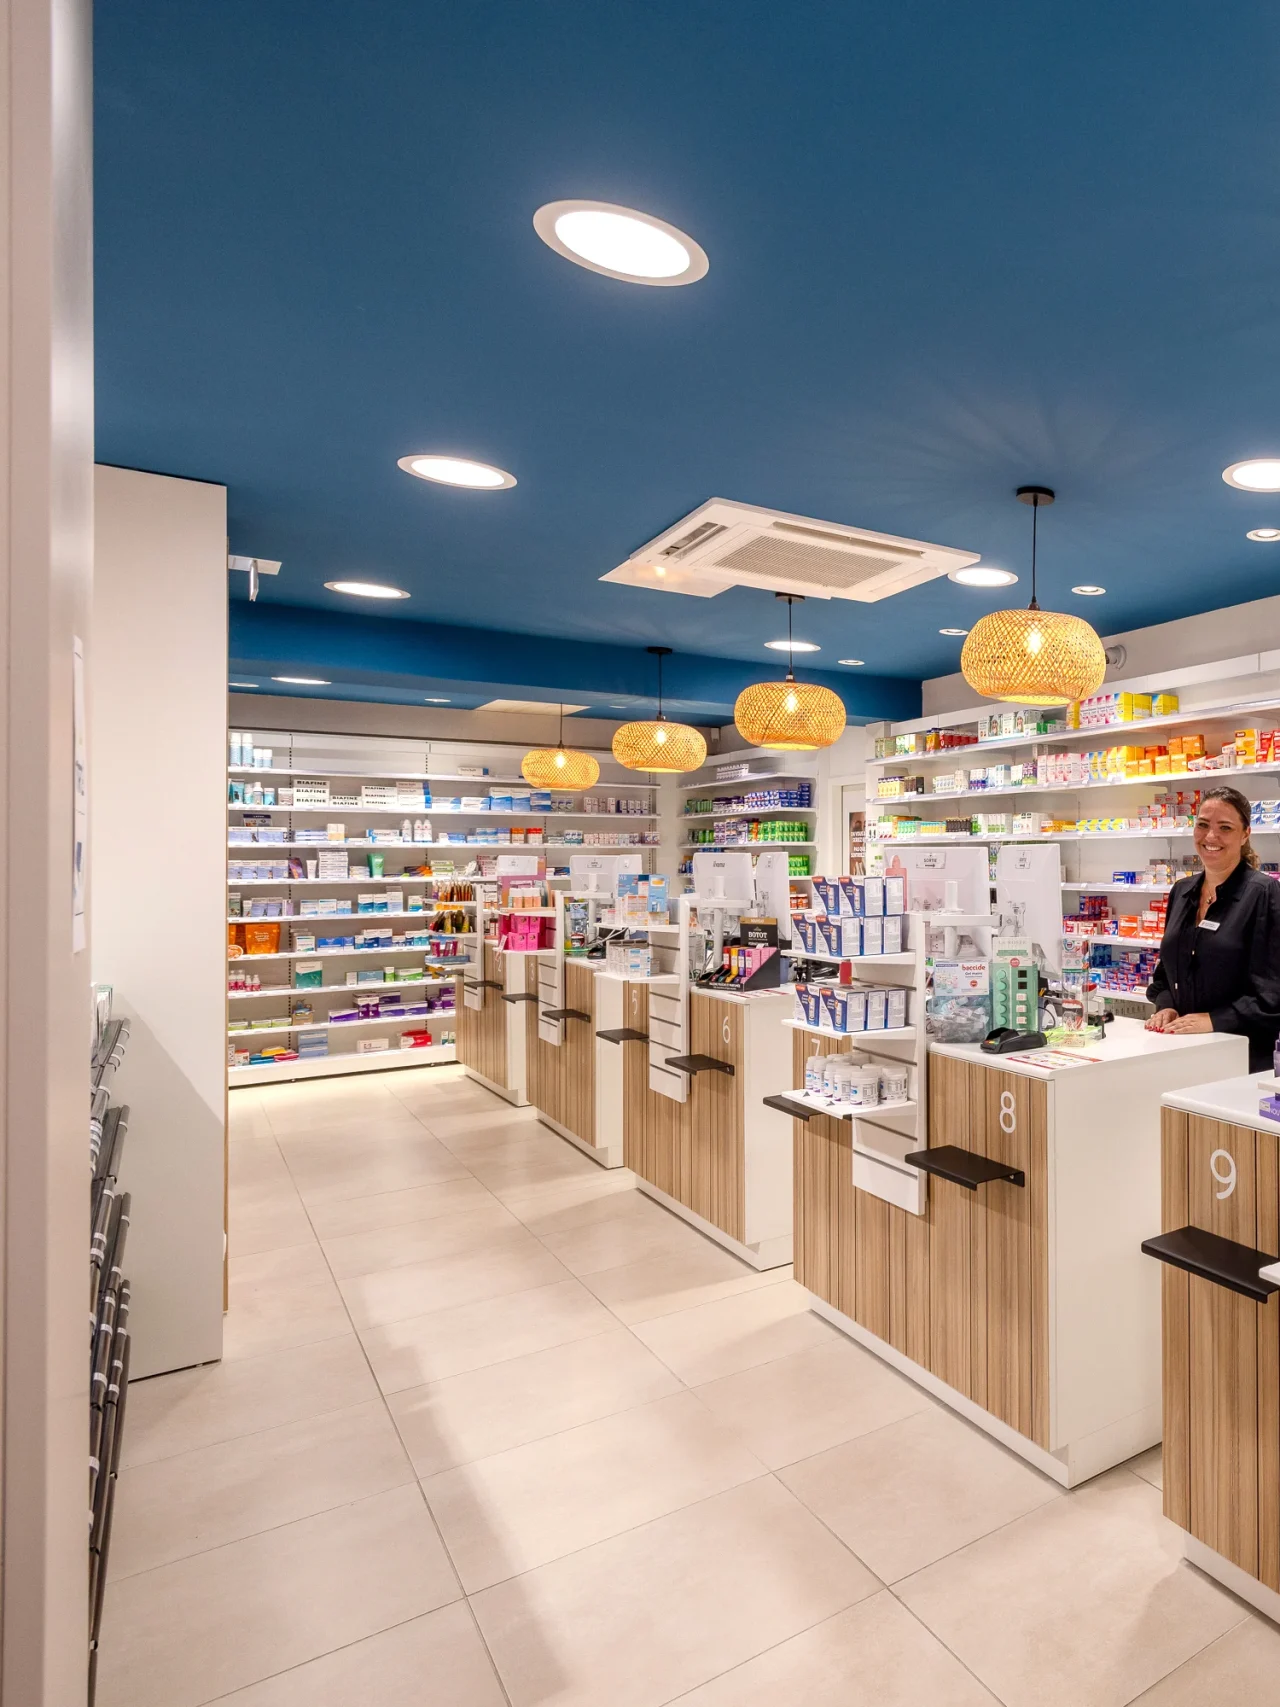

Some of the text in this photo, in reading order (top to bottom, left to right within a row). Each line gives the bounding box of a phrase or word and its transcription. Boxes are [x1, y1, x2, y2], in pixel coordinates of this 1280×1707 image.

[723, 1016, 731, 1043] 6
[1000, 1090, 1017, 1133] 8
[1210, 1149, 1237, 1199] 9
